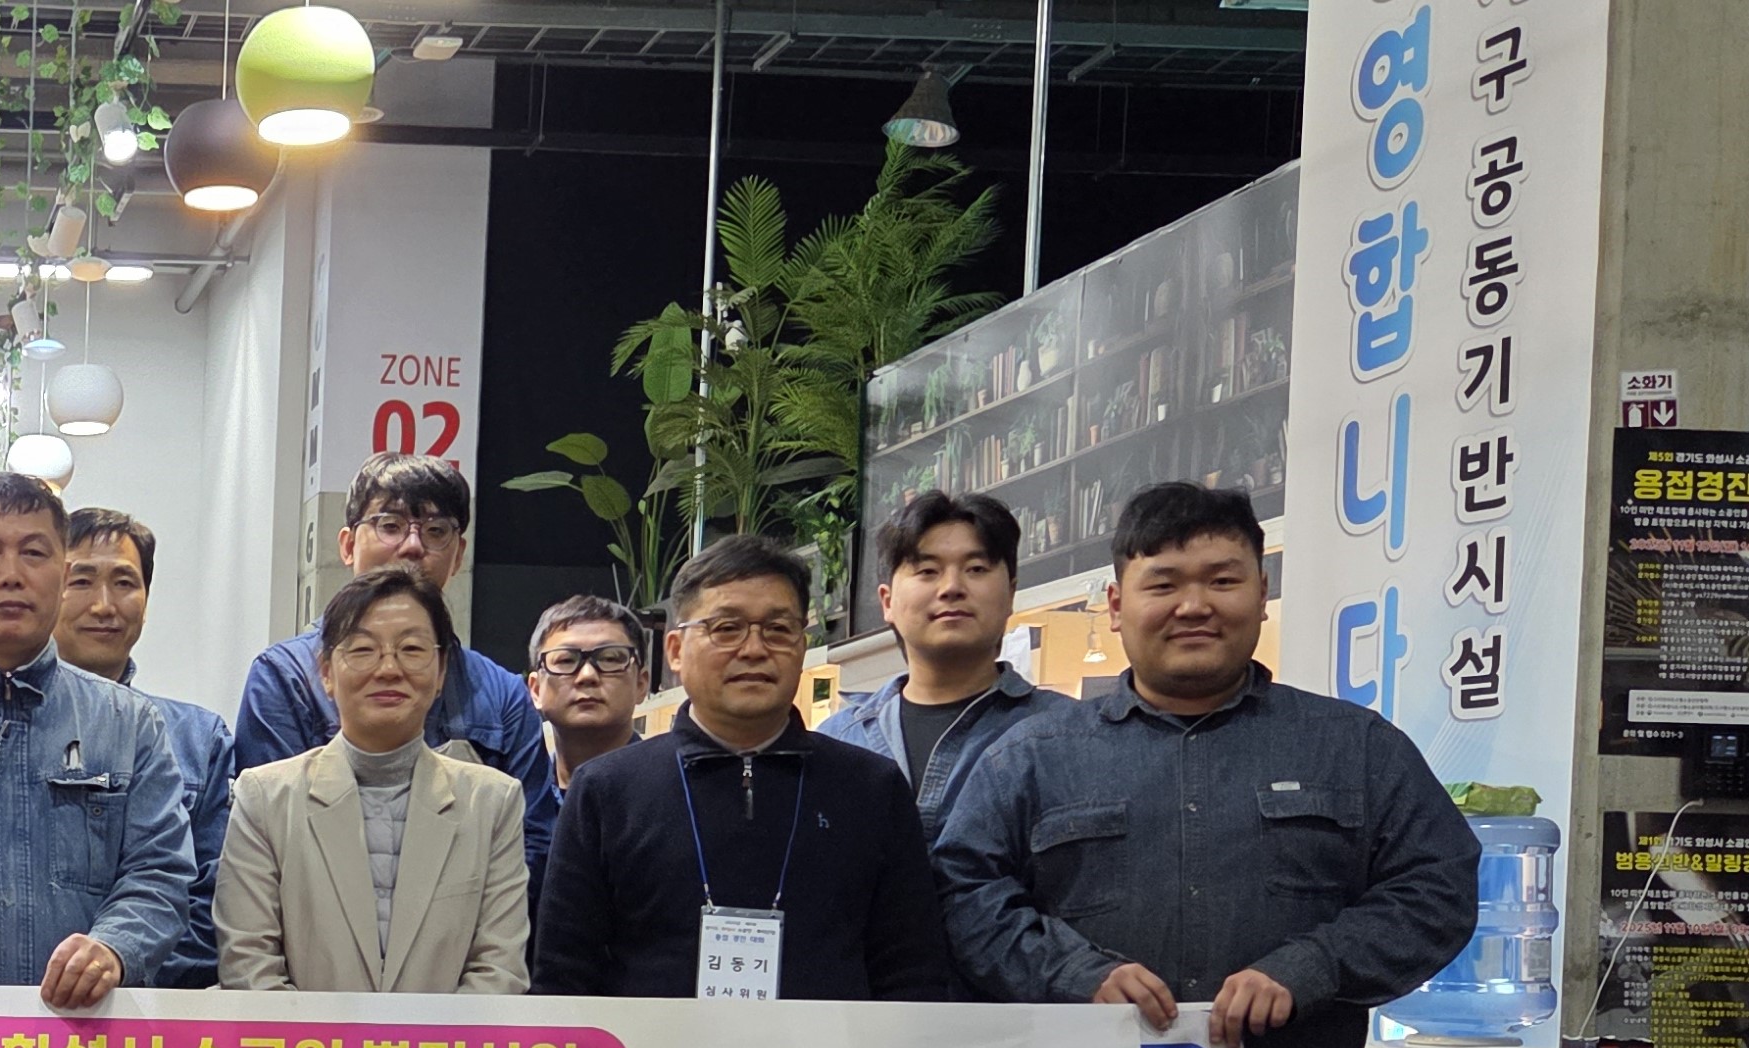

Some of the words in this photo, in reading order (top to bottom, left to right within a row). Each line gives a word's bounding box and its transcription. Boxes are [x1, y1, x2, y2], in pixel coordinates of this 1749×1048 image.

[380, 354, 461, 387] ZONE
[1337, 3, 1431, 721] 영합니다
[1627, 375, 1672, 389] 소화기
[372, 400, 460, 471] 02
[1648, 451, 1673, 462] 제5회
[1676, 452, 1703, 463] 경기도
[1706, 454, 1734, 464] 화성시
[1665, 837, 1693, 846] 기도
[1695, 838, 1723, 848] 화성시
